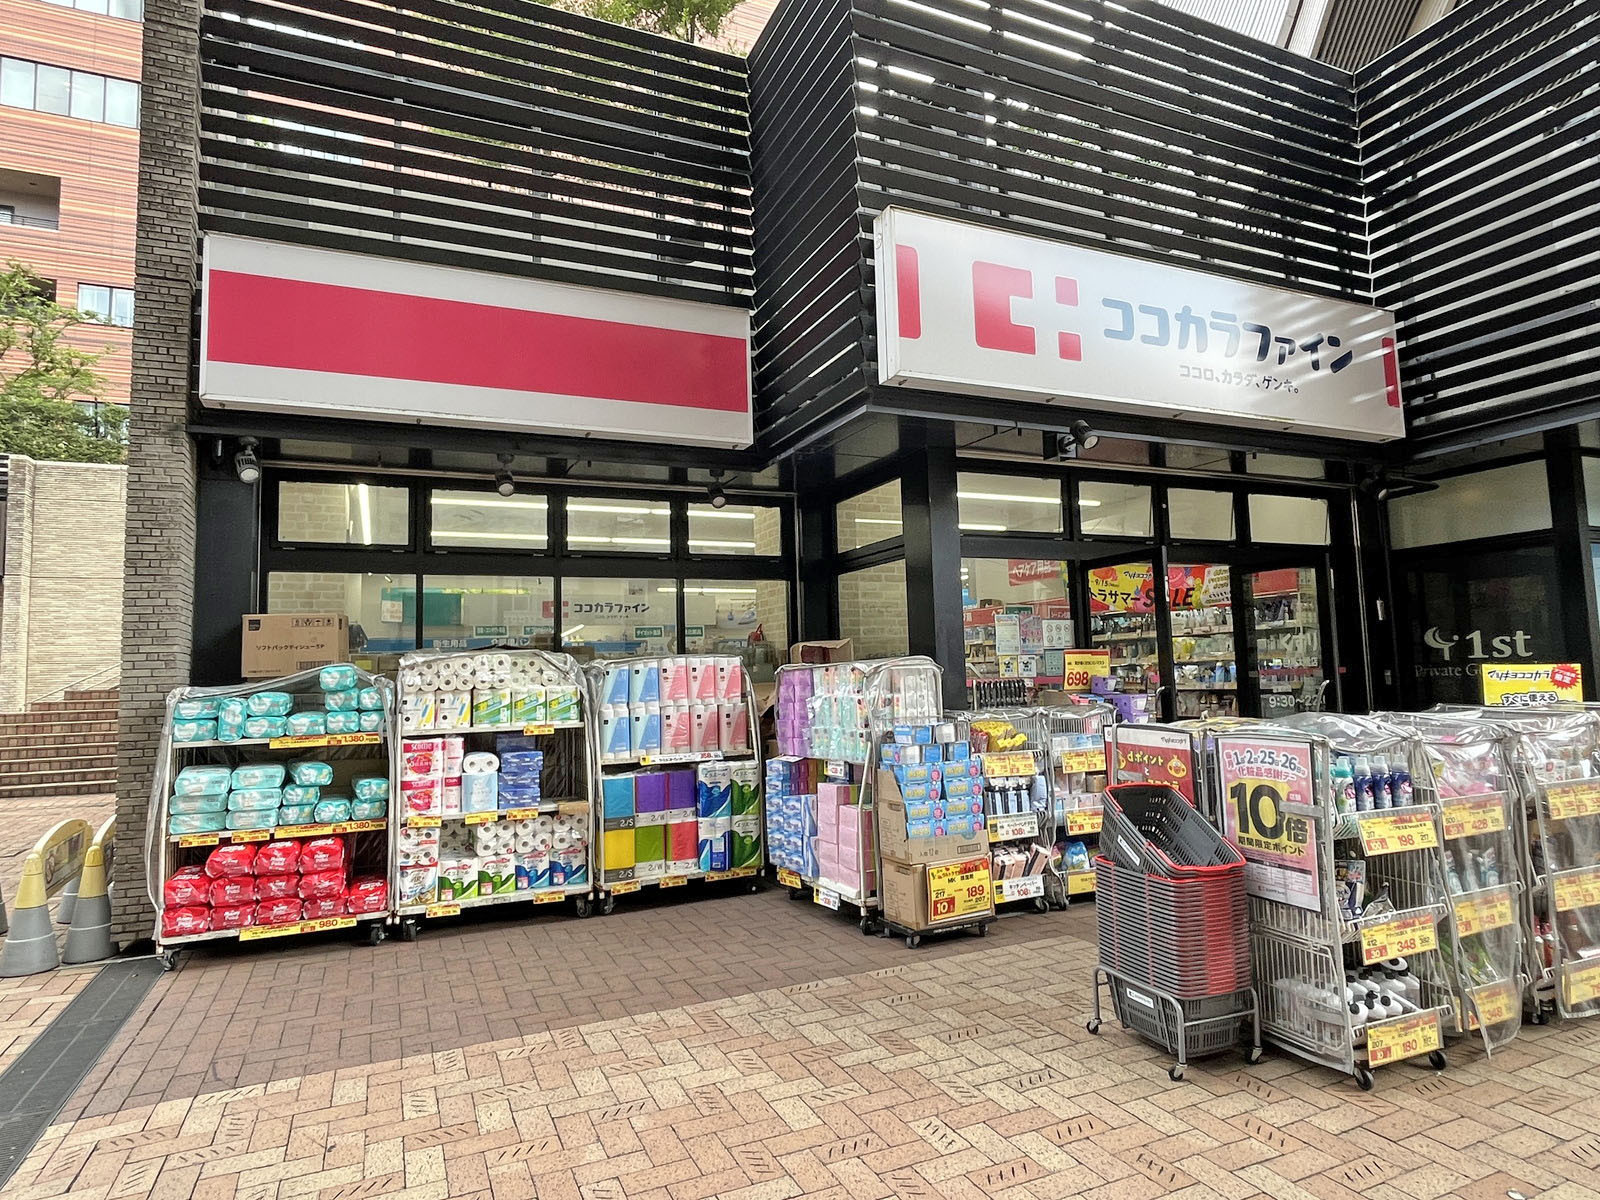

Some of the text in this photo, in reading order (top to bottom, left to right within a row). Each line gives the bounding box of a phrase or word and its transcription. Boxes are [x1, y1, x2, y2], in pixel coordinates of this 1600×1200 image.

[1101, 298, 1353, 374] ココカラファイン
[1142, 586, 1195, 608] SLE
[573, 602, 650, 613] ココカラファイン
[1465, 630, 1533, 658] 1st
[1414, 663, 1482, 677] Private G
[1066, 671, 1089, 686] 698
[1503, 693, 1557, 703] すぐに使える
[1127, 750, 1164, 766] dポイント
[1237, 835, 1305, 857] 期間限定ポイント
[1397, 834, 1415, 847] 198
[966, 884, 985, 898] 189
[936, 901, 948, 914] 10
[319, 919, 338, 928] 980
[1396, 938, 1416, 952] 348
